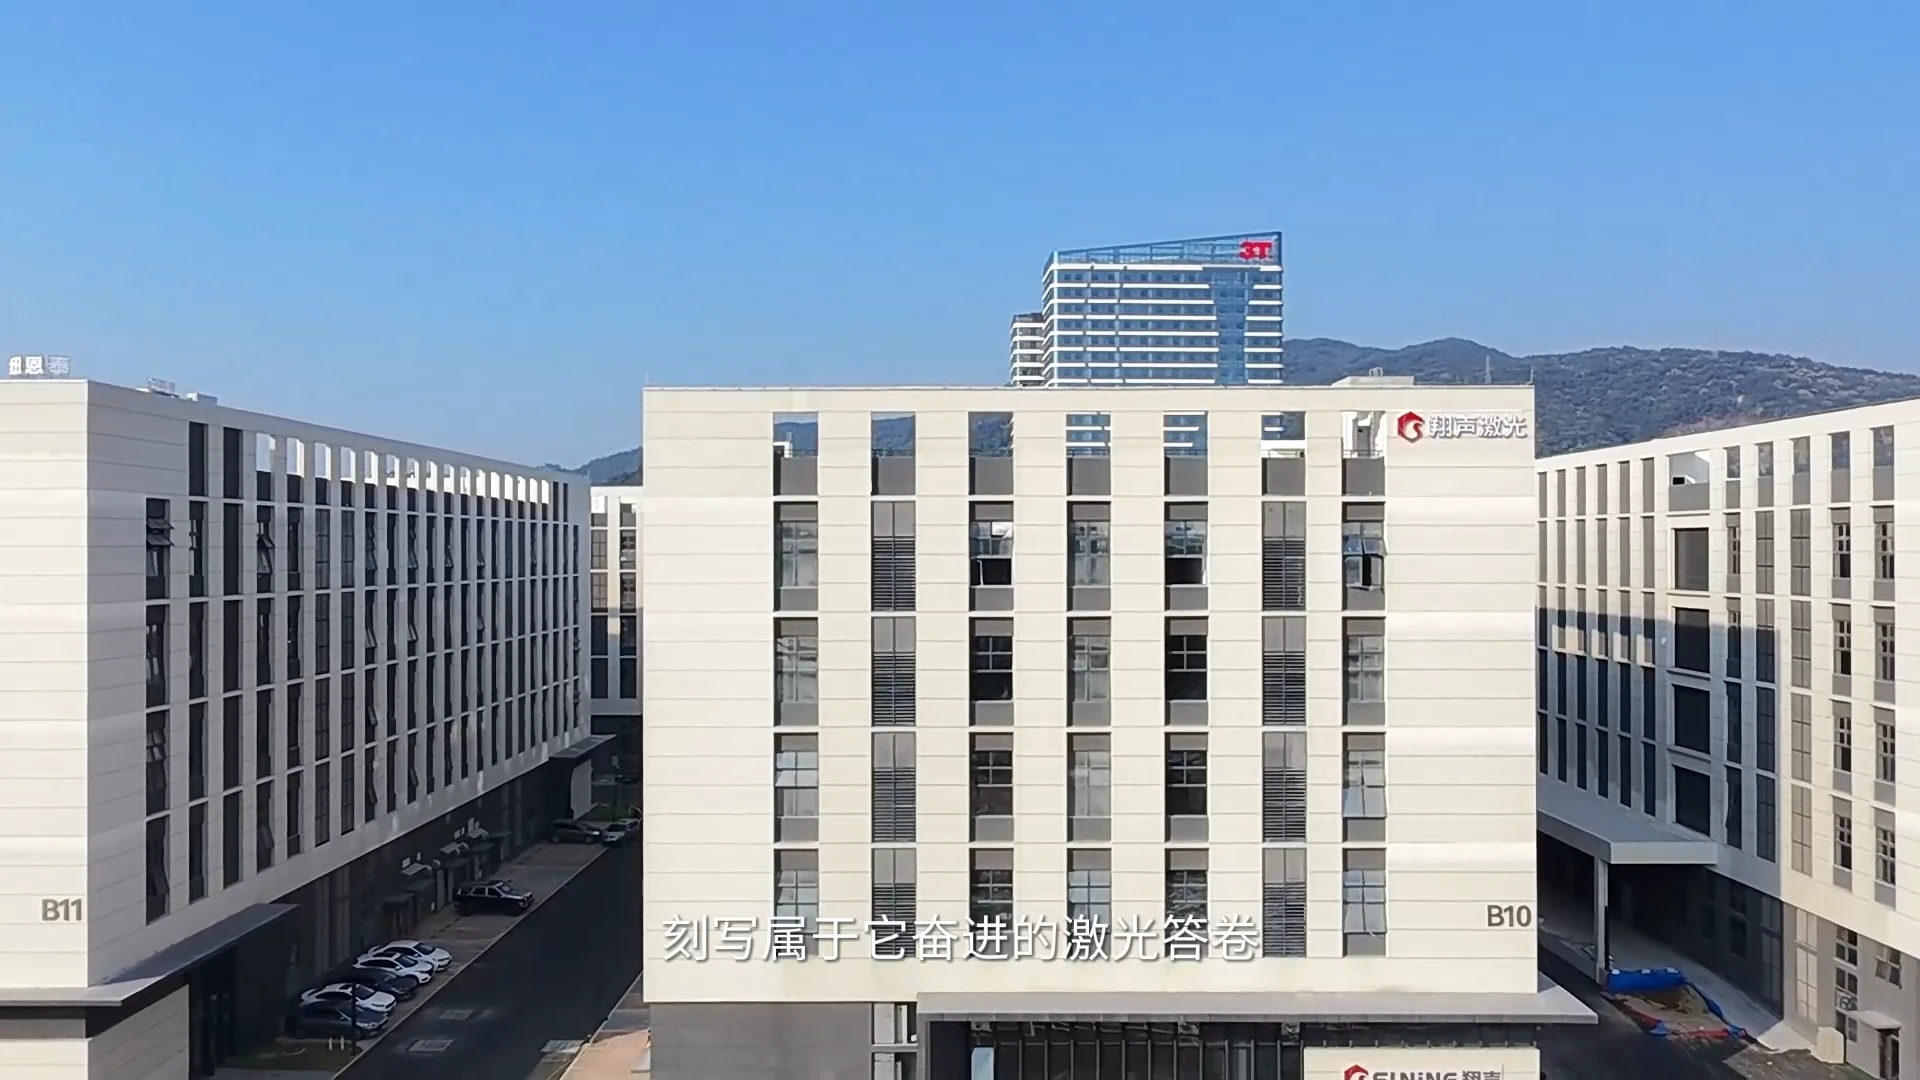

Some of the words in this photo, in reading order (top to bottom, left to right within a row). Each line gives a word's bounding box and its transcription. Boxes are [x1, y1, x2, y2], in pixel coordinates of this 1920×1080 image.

[1239, 241, 1272, 259] 3T
[1429, 415, 1528, 438] 翔声激光
[42, 898, 82, 921] B11
[1487, 904, 1531, 927] B10
